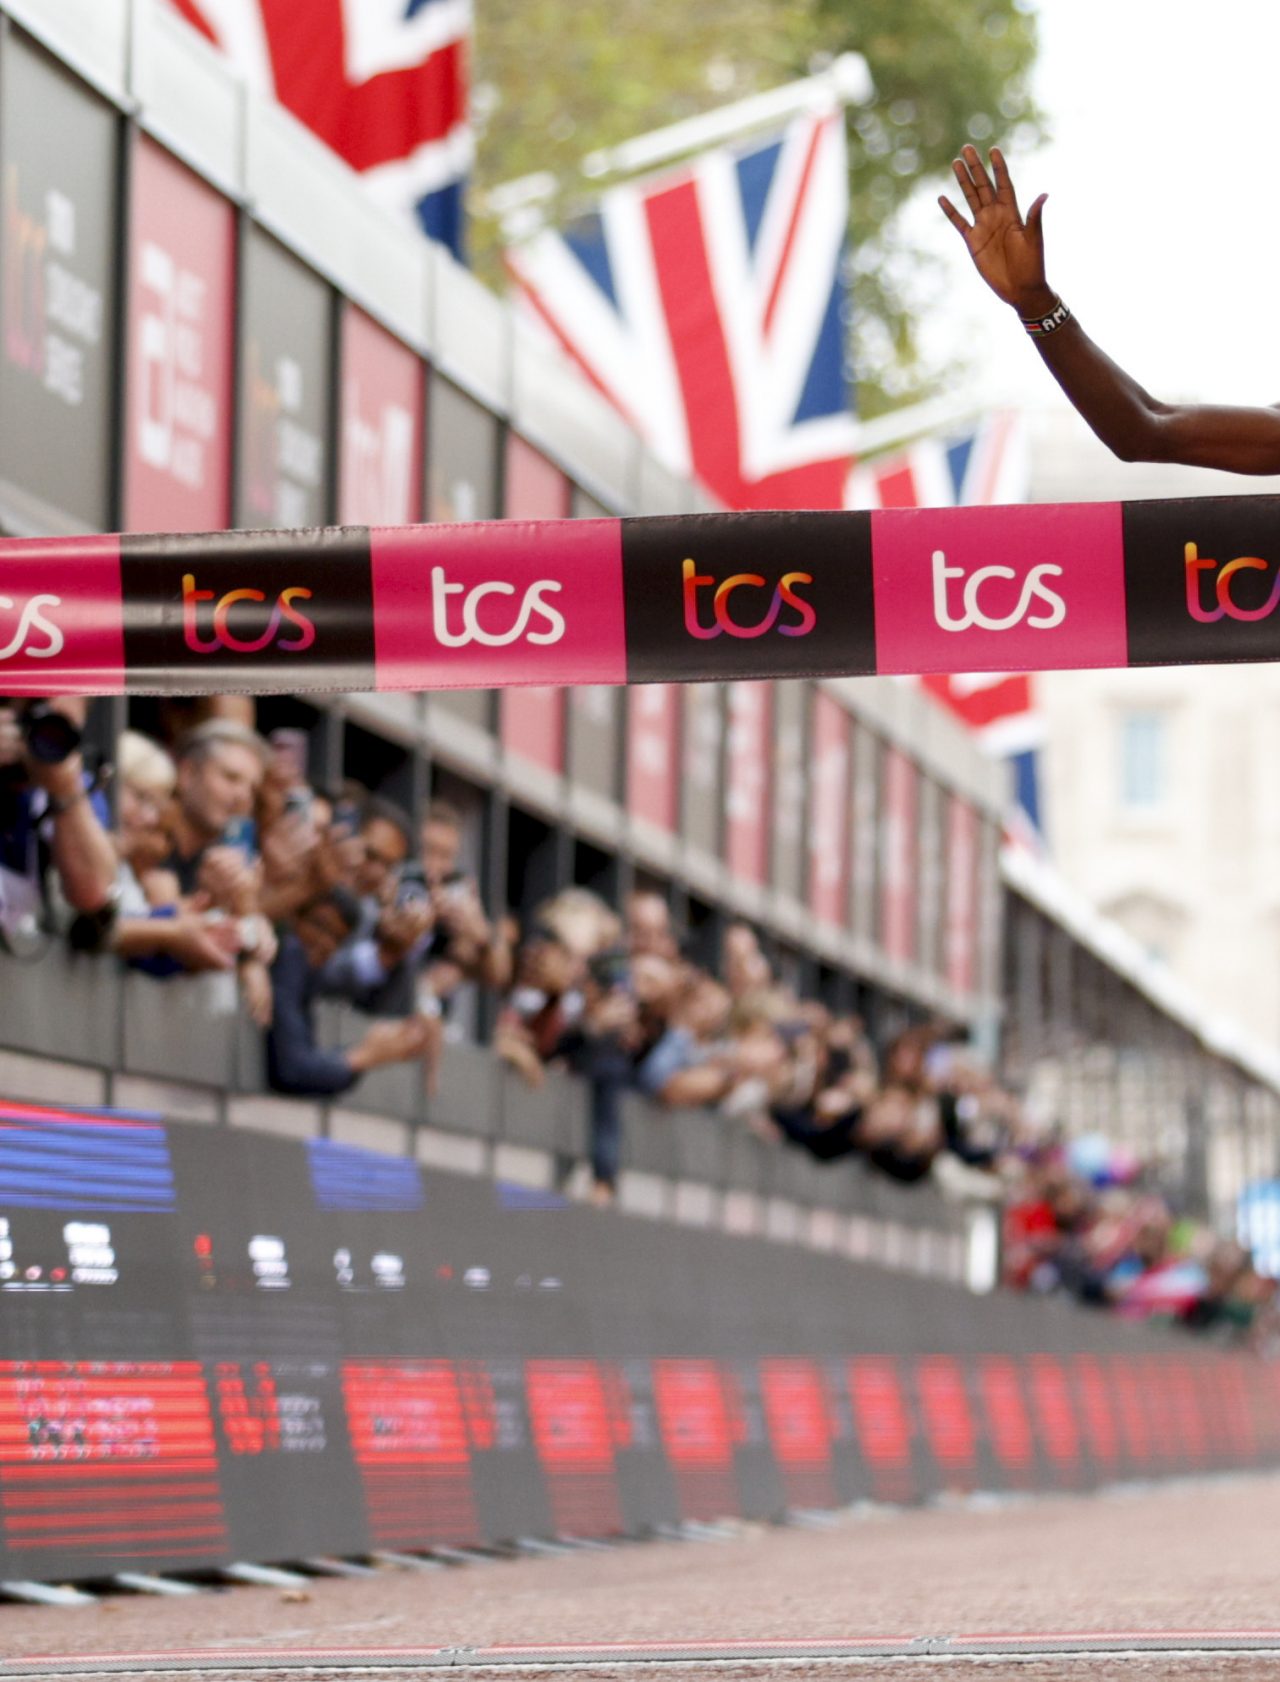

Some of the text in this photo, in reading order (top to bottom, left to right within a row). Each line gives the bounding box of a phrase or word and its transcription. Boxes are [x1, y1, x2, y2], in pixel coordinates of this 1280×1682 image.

[181, 574, 315, 653] tcs
[431, 566, 566, 648] tcs
[682, 558, 817, 641] tcs
[931, 550, 1067, 632] tcs
